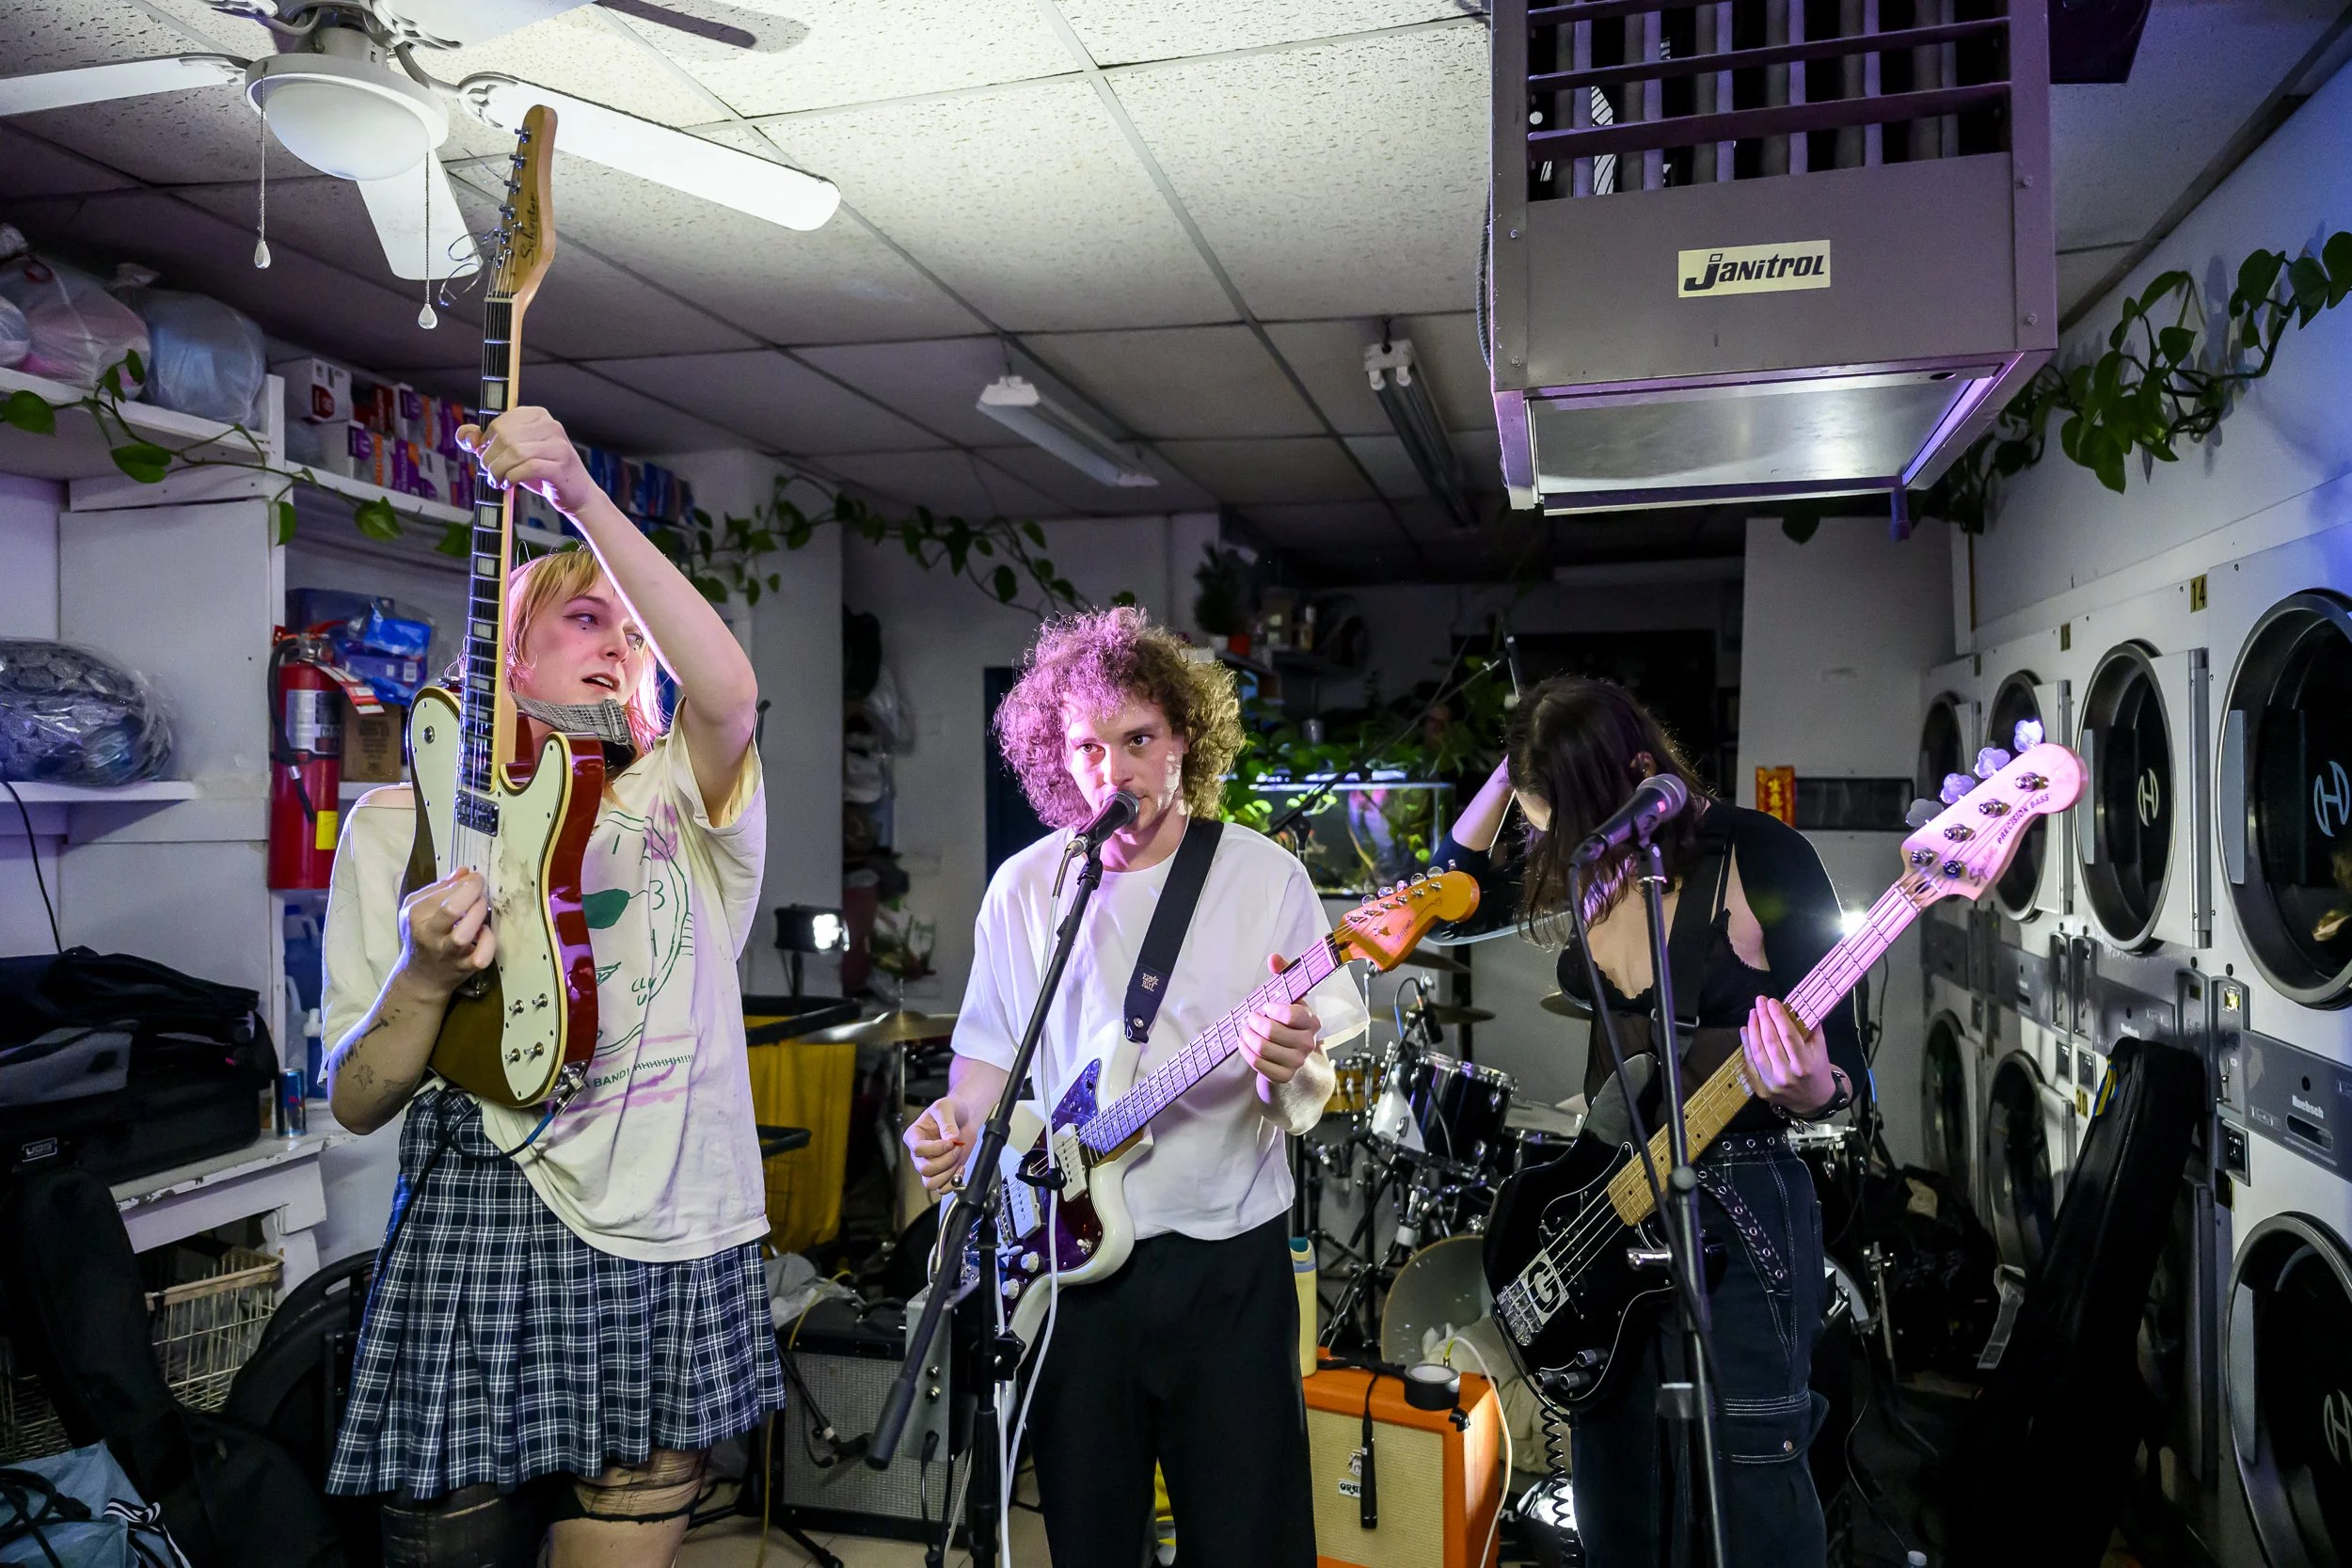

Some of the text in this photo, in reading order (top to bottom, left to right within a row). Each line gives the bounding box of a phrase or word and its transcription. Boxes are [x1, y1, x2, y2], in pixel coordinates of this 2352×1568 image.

[2191, 578, 2206, 610] 14
[1996, 793, 2050, 845] PRECISION BASS
